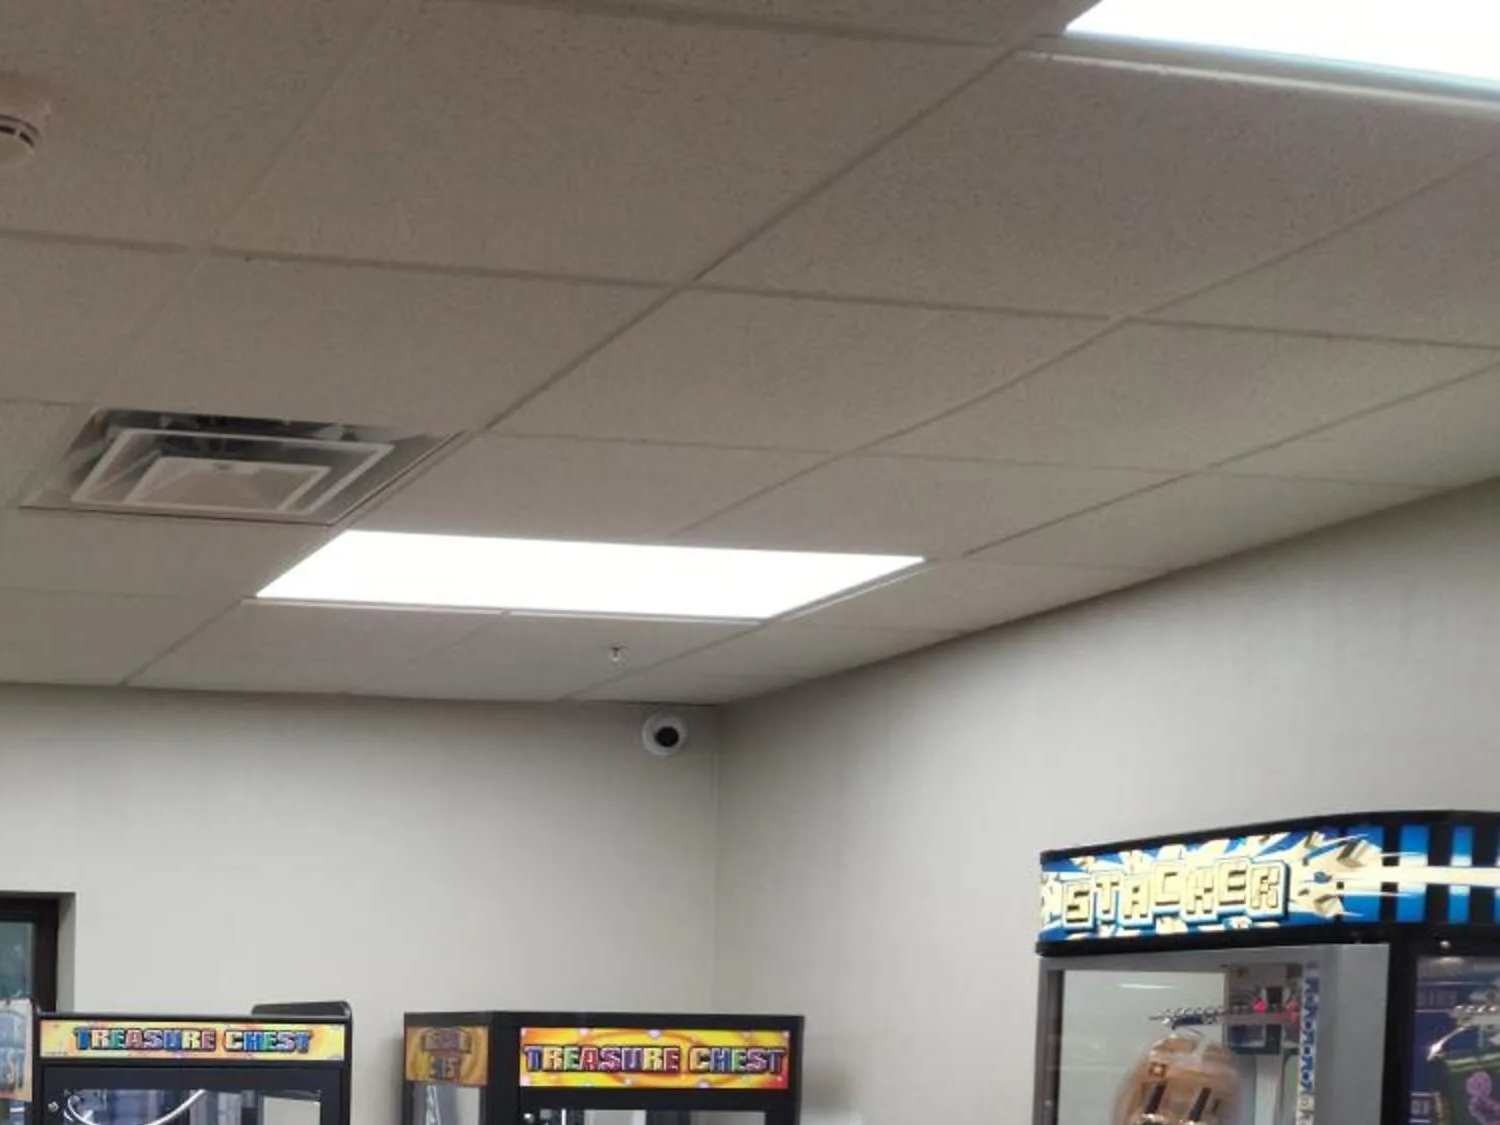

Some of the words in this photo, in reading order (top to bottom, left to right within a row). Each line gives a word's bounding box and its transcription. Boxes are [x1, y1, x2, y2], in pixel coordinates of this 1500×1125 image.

[1062, 858, 1288, 928] STACKER
[74, 1027, 216, 1054] TREASURE
[223, 1028, 312, 1054] CHEST
[523, 1045, 681, 1074] TREASURE
[688, 1046, 788, 1075] CHEST
